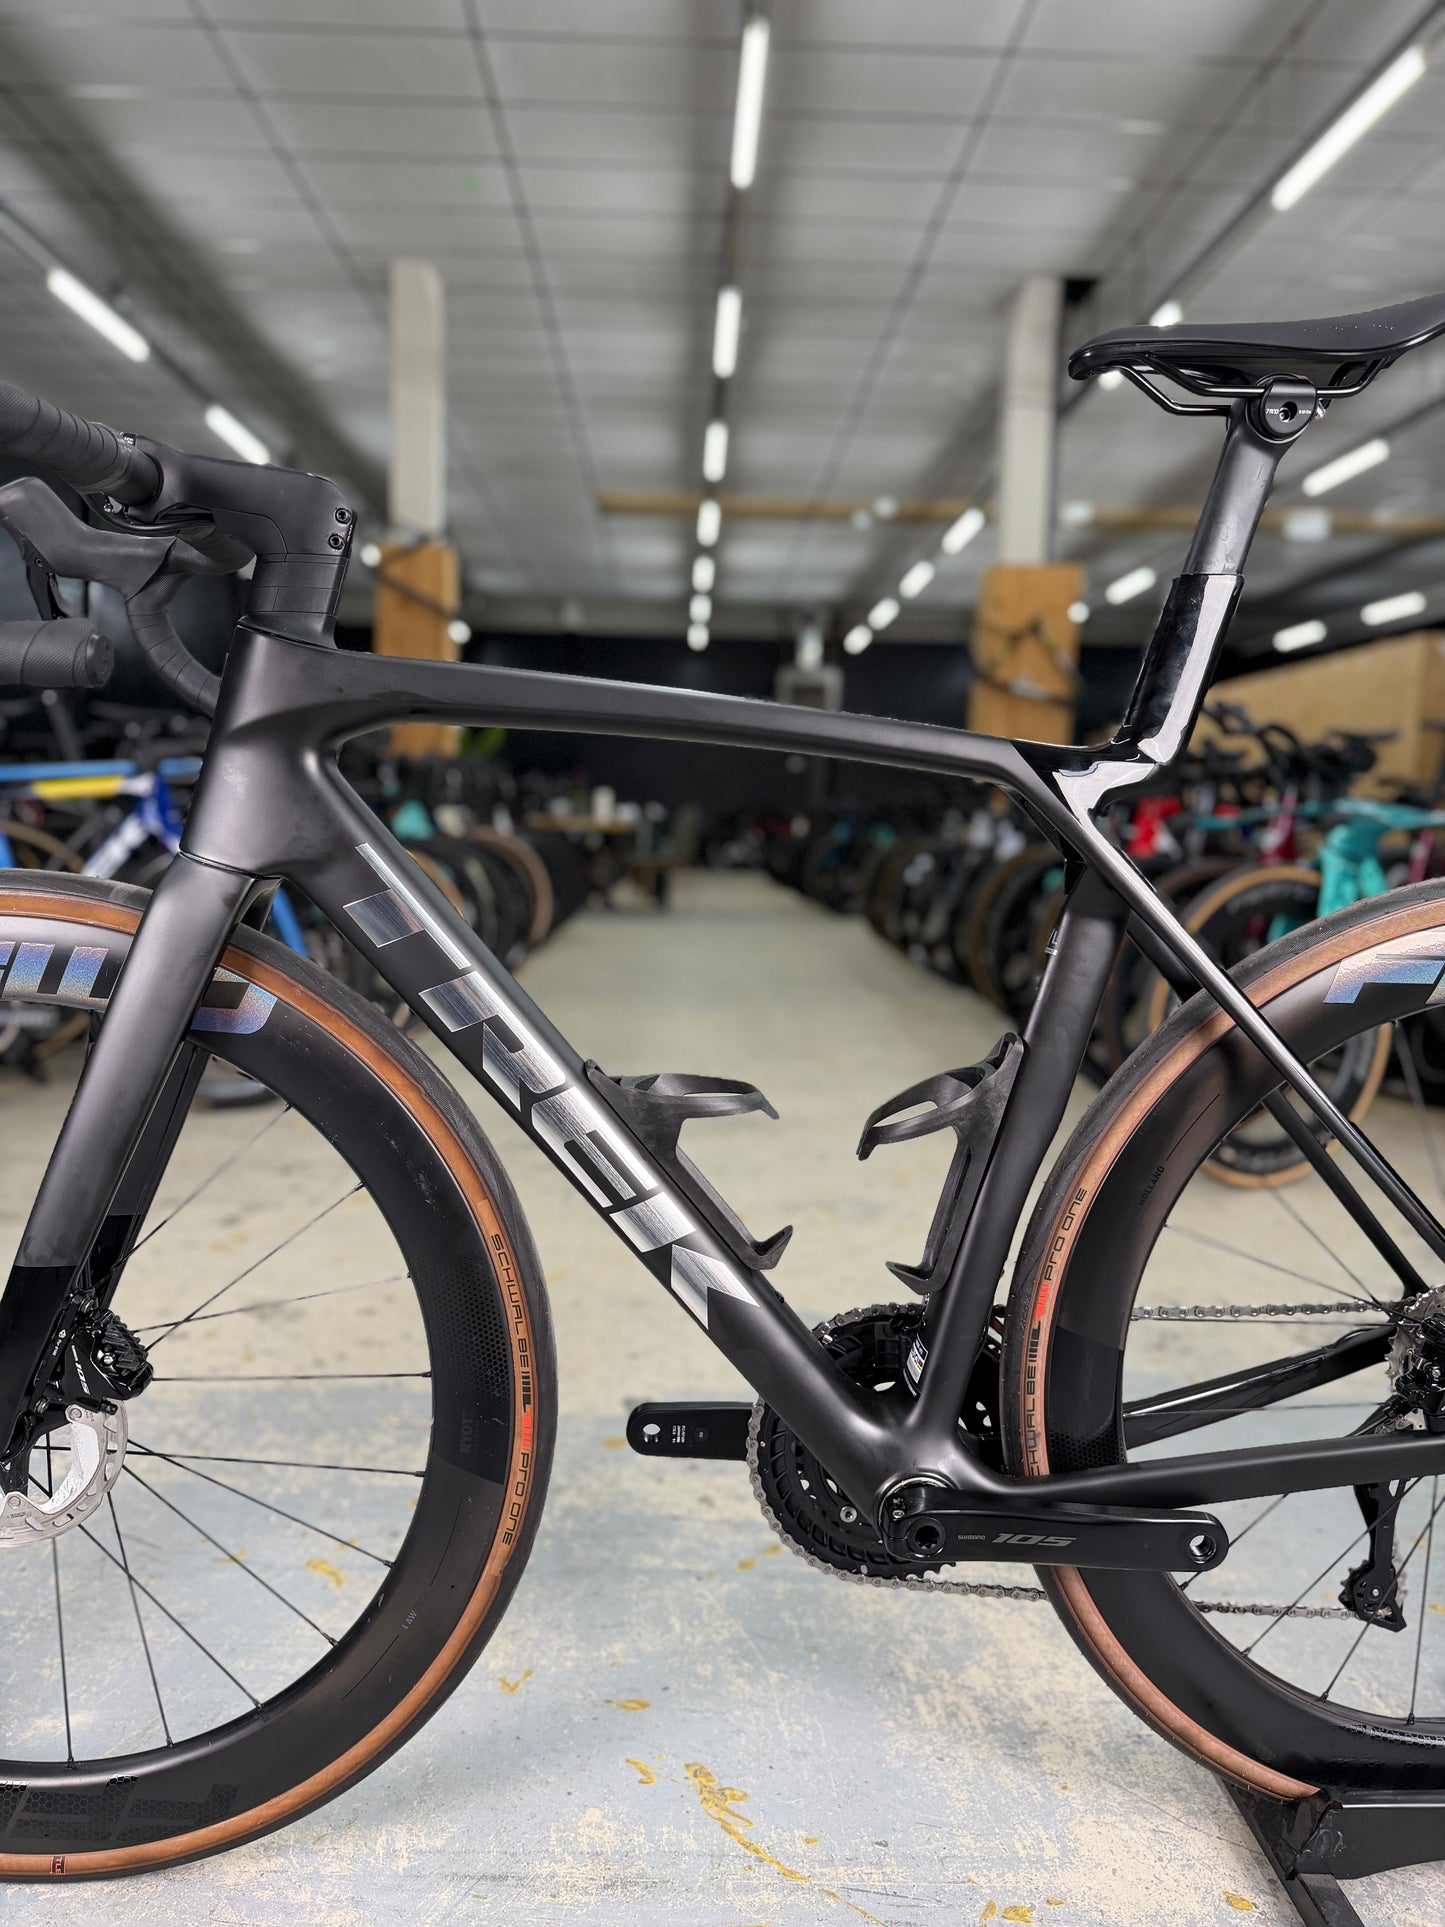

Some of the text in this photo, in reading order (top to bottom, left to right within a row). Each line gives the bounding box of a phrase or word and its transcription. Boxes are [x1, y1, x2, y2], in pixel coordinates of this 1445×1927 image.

[343, 843, 760, 1331] TREK
[1138, 1166, 1165, 1207] HOLLAND
[491, 1233, 529, 1368] SCHWALBE
[75, 1362, 91, 1396] 105
[1026, 1366, 1040, 1477] CHWALBE
[991, 1533, 1077, 1547] 105
